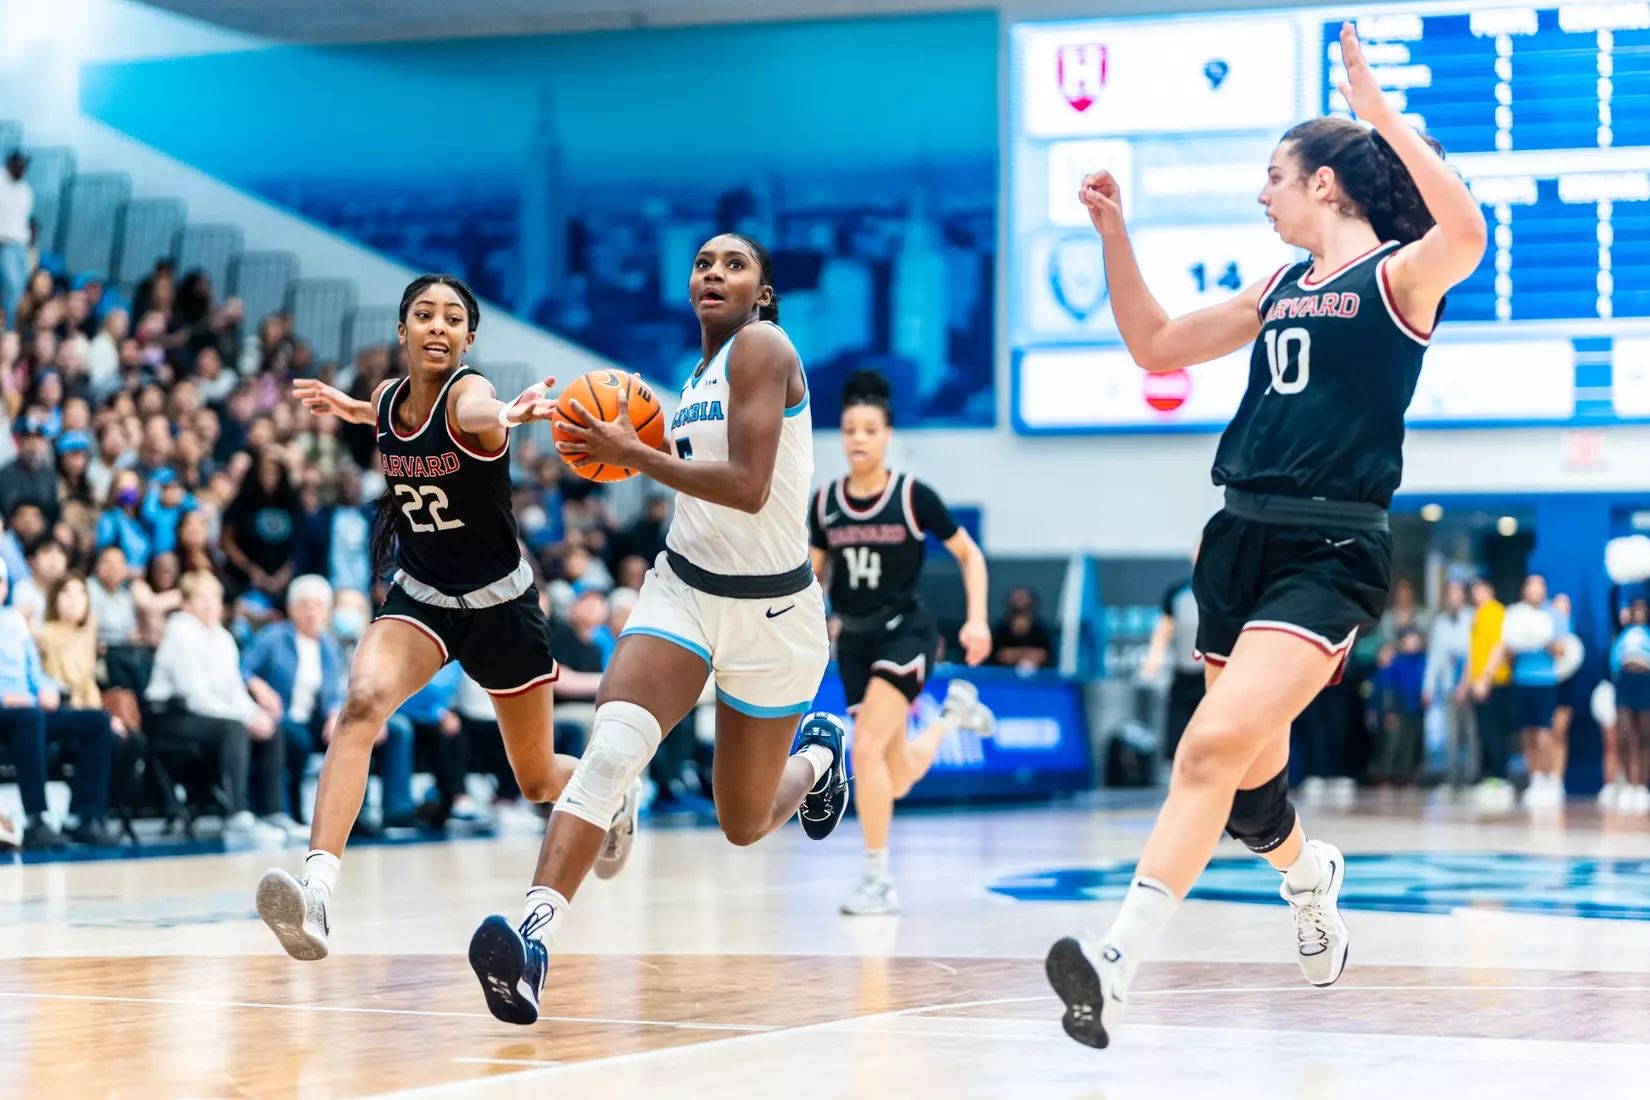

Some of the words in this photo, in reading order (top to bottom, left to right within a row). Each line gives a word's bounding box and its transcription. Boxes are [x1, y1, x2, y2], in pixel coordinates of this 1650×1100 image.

[1204, 59, 1229, 90] 9
[1189, 261, 1242, 292] 14
[1264, 327, 1311, 395] 10
[394, 483, 466, 533] 22
[842, 546, 882, 590] 14
